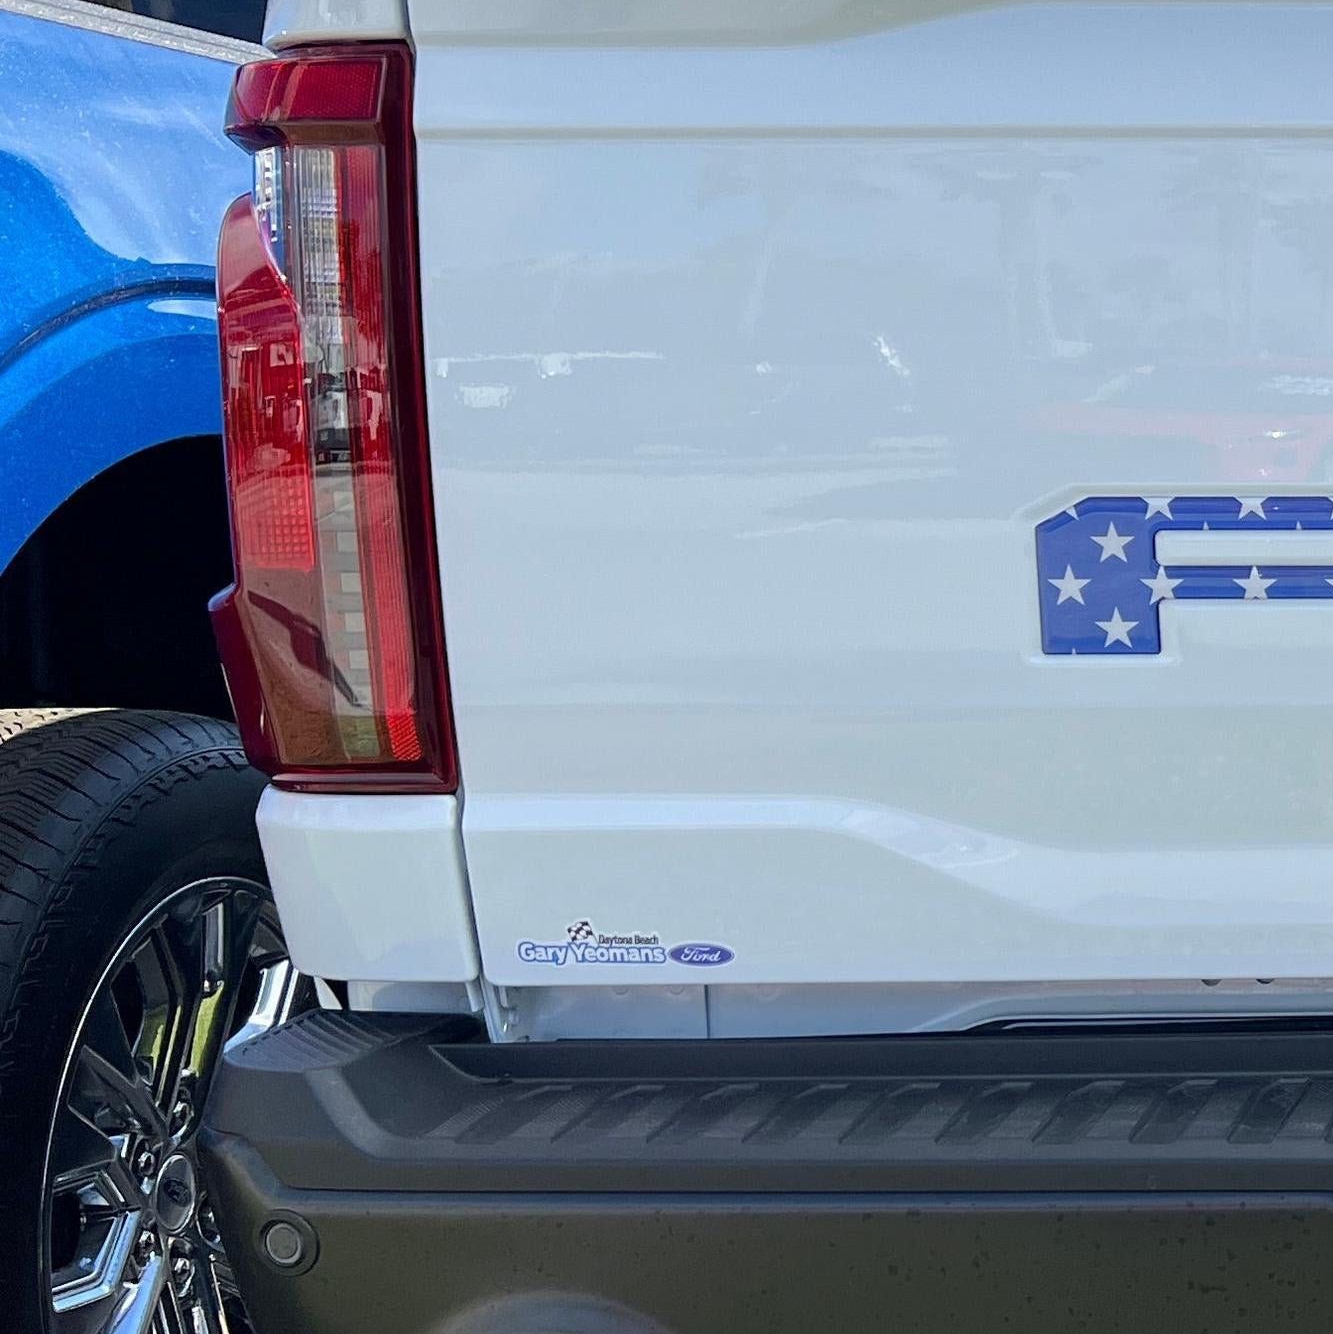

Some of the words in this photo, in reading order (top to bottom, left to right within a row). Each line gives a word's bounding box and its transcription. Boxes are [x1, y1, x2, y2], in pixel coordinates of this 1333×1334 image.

[598, 934, 633, 947] Daytona
[634, 934, 660, 946] Beach
[518, 941, 568, 965] Gary
[567, 942, 668, 964] Yeomans
[680, 946, 721, 962] Ford
